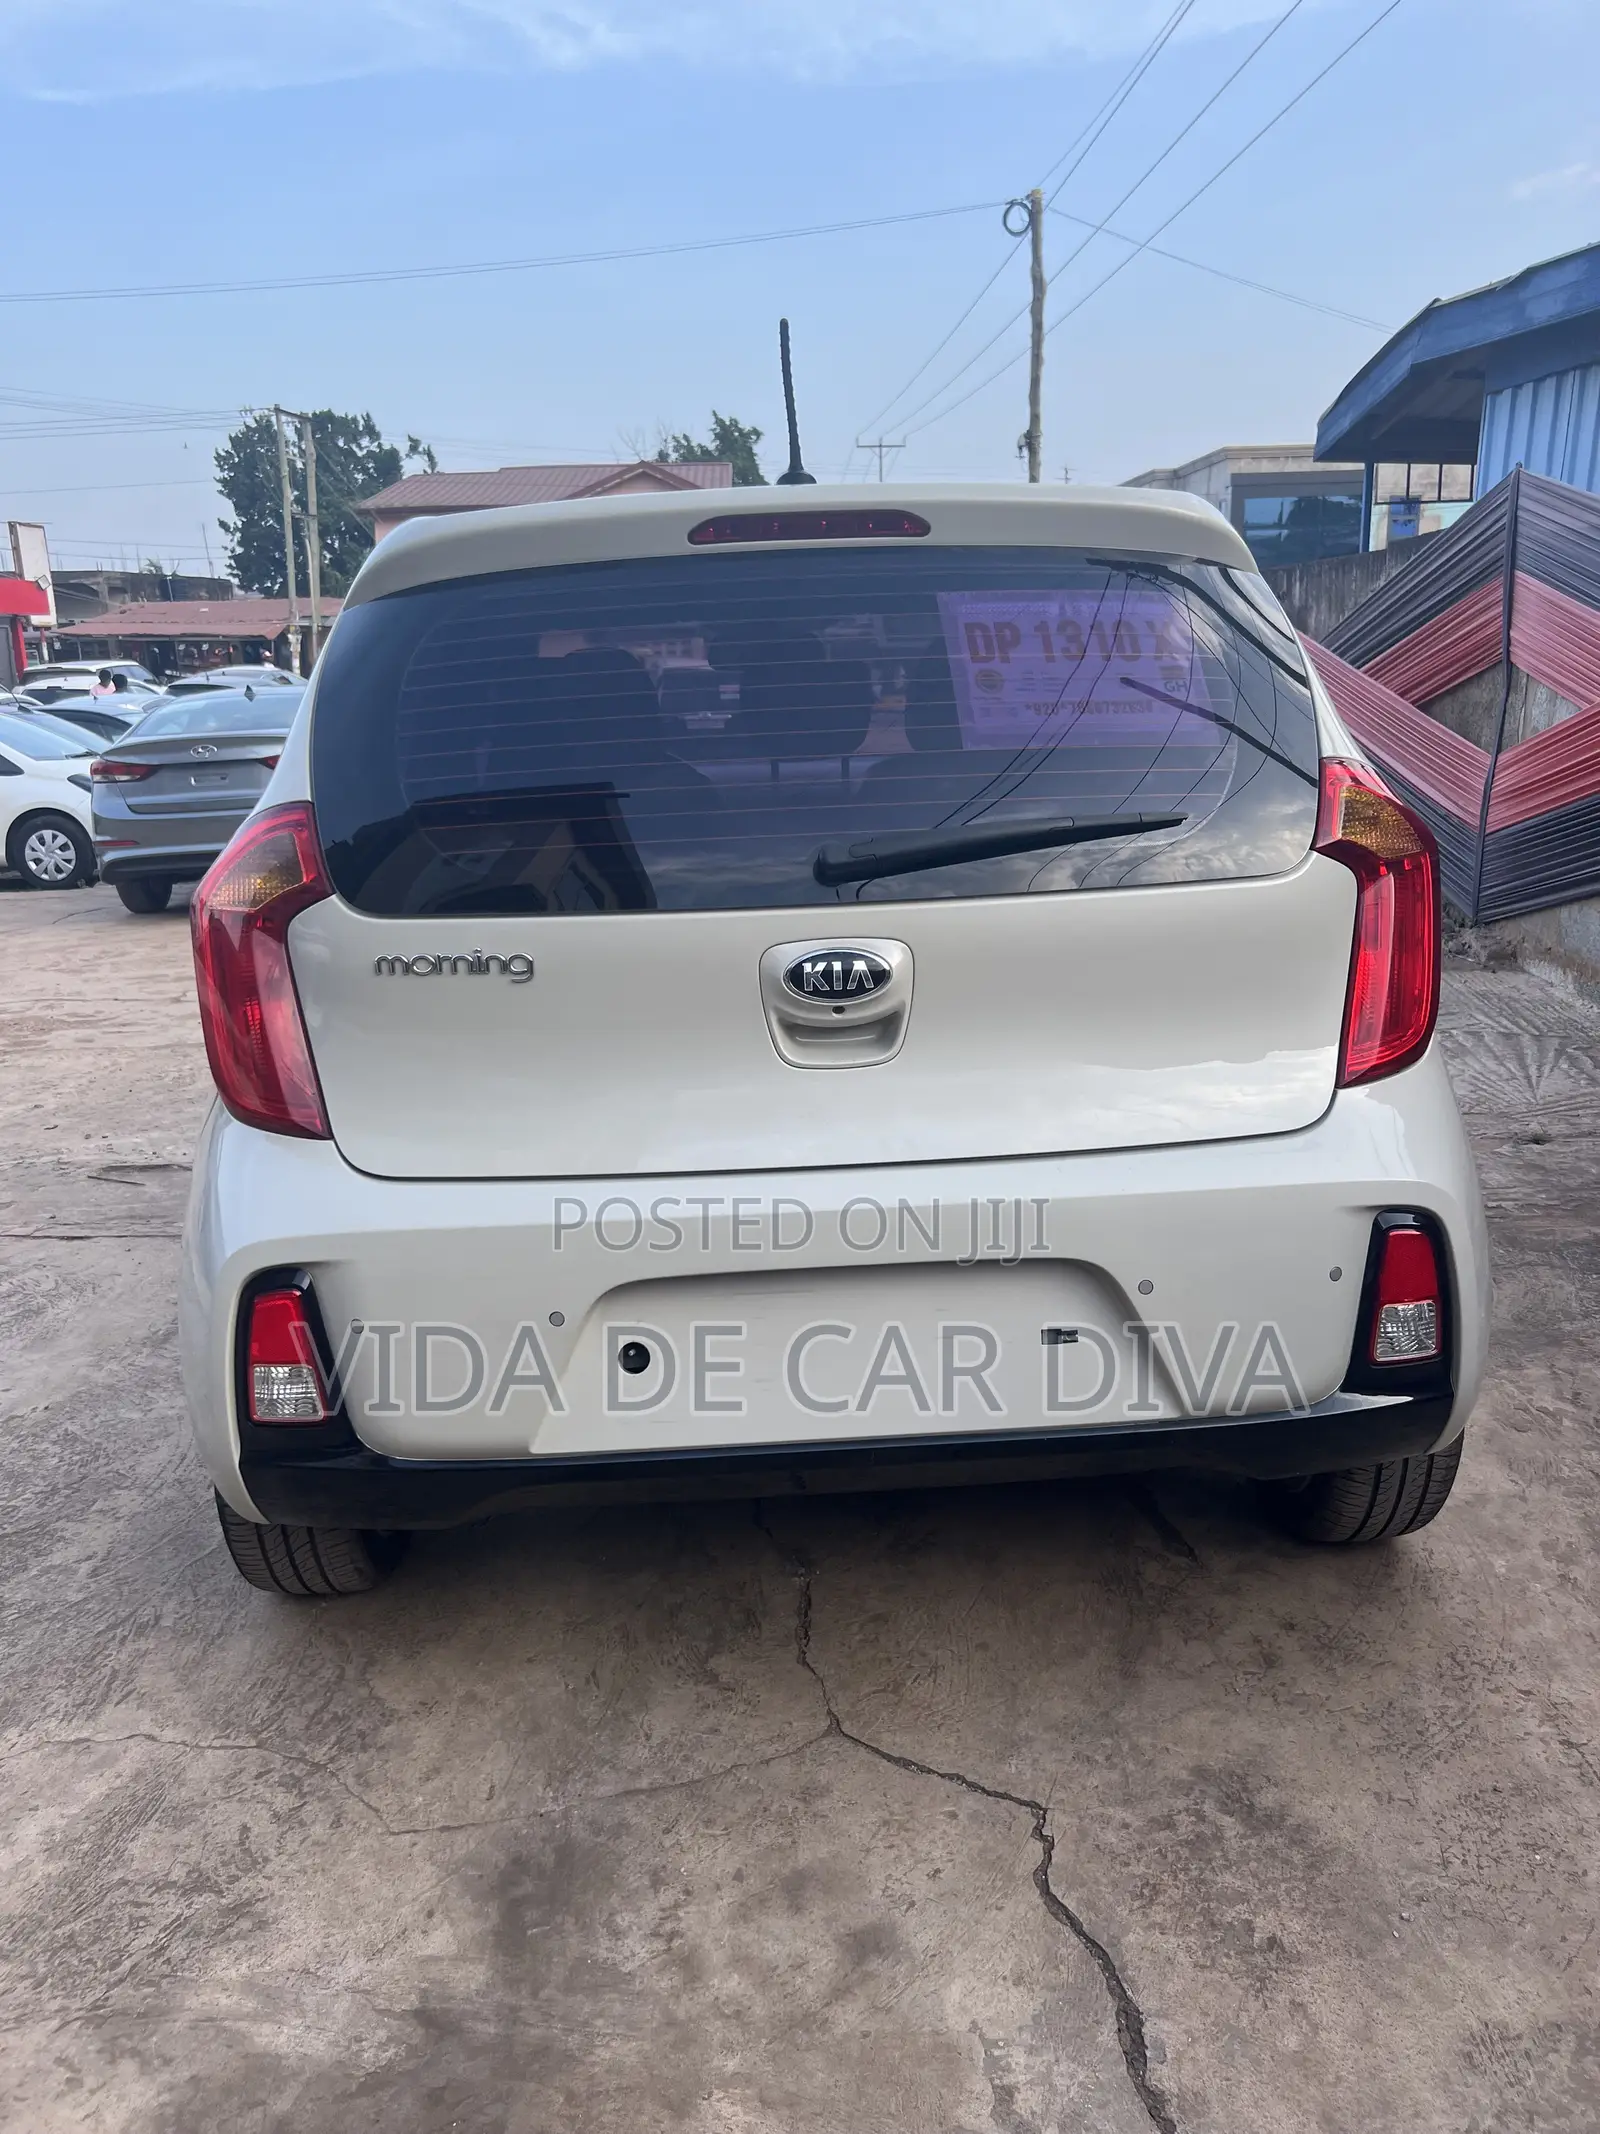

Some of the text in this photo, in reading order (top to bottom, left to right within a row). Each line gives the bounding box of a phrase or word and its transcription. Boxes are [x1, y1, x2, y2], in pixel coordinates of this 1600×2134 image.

[964, 620, 1021, 664] DP
[1034, 619, 1142, 663] 1310
[1163, 680, 1188, 694] GH
[375, 947, 534, 983] morning
[801, 960, 874, 992] KIA
